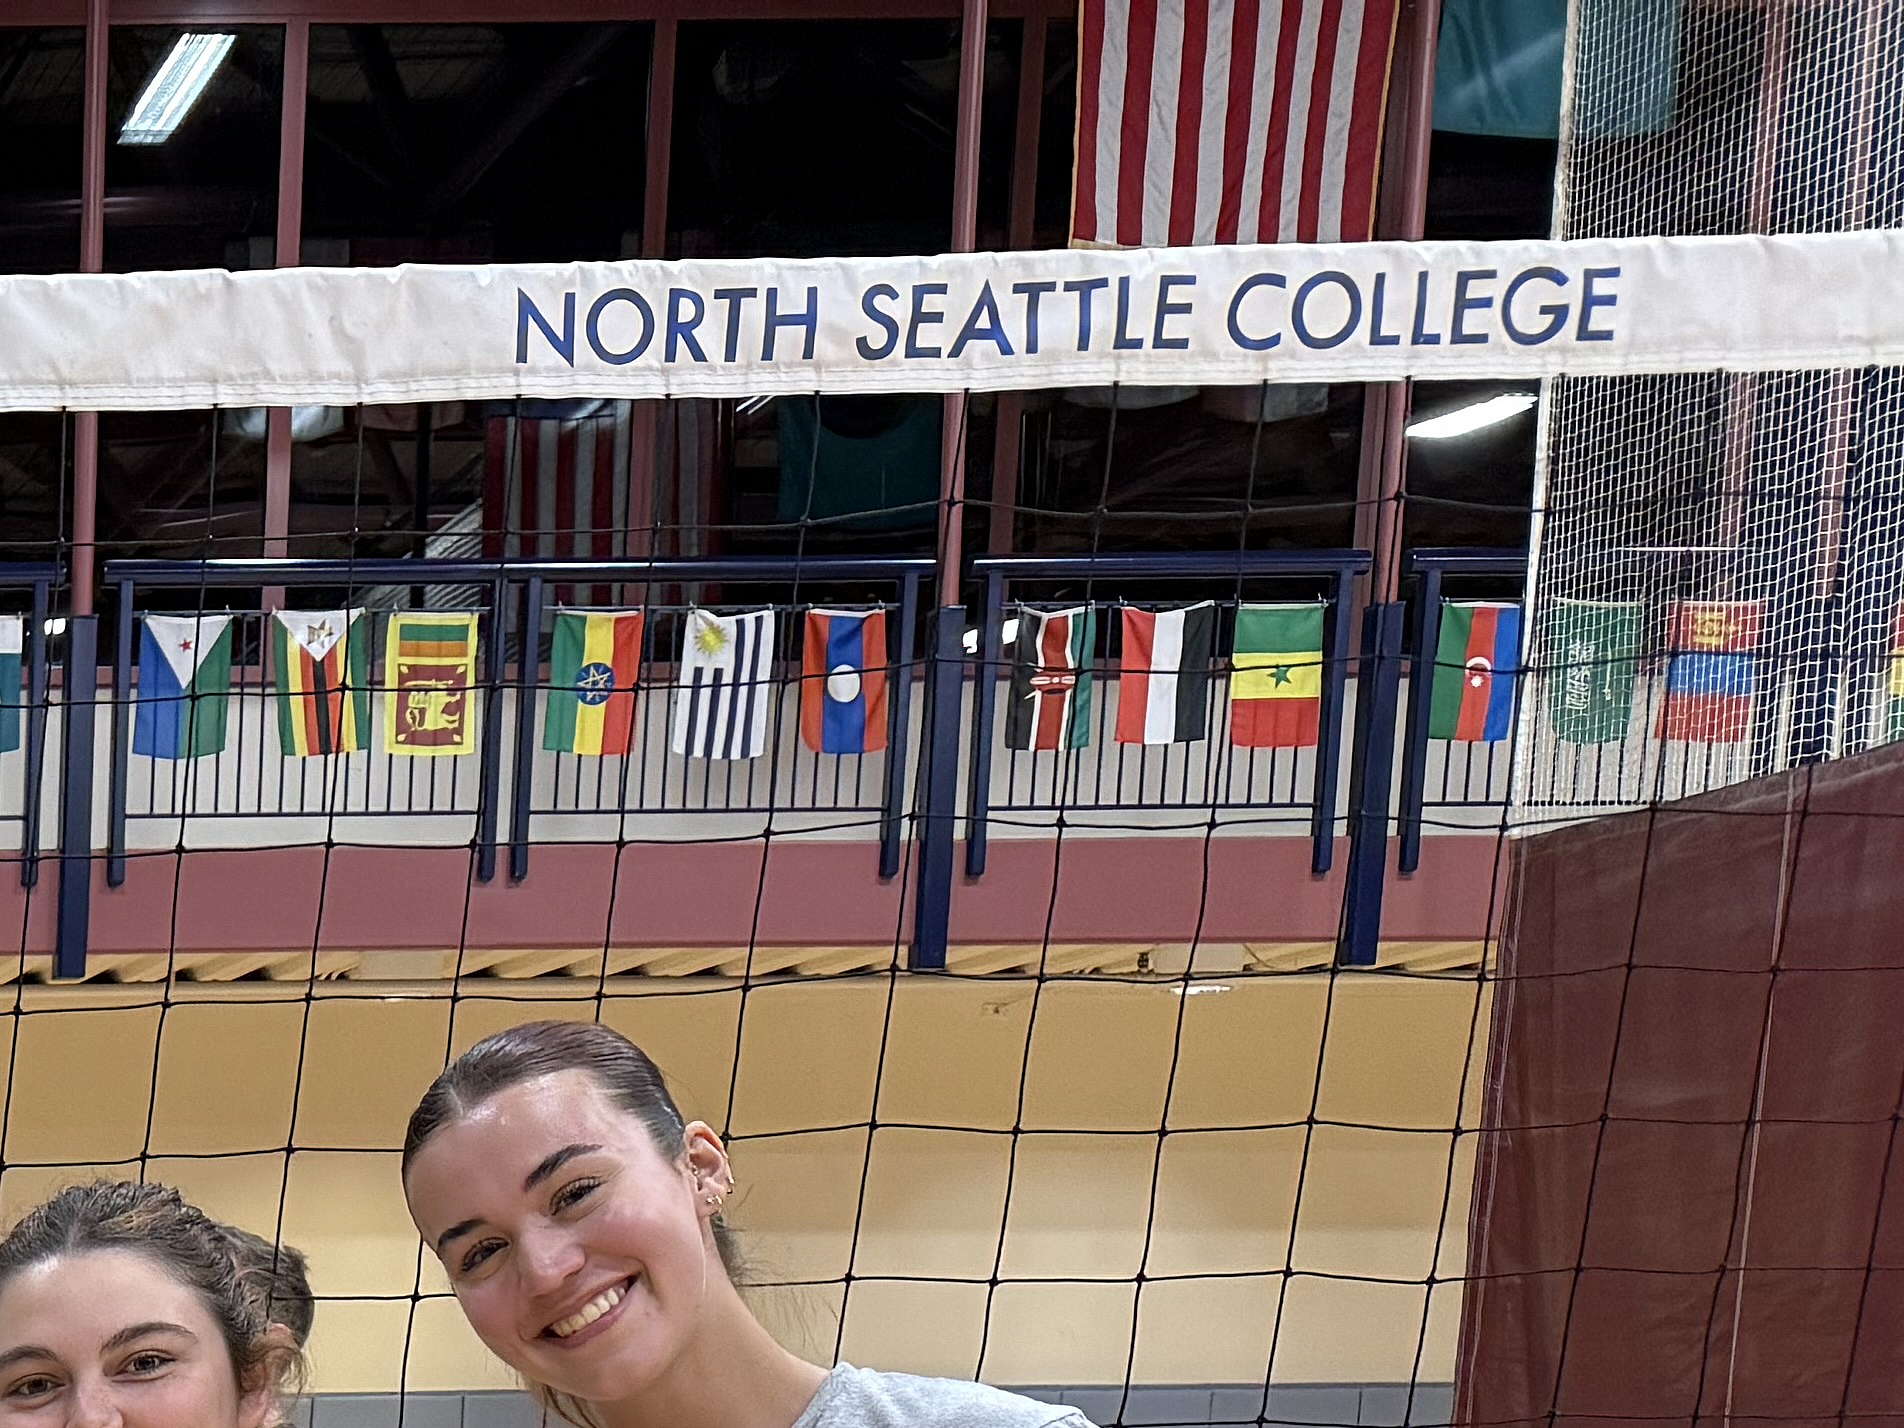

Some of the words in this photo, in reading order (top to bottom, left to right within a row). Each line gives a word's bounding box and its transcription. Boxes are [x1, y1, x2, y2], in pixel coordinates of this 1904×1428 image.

[515, 287, 819, 366] NORTH
[855, 275, 1198, 359] SEATTLE
[1229, 267, 1623, 351] COLLEGE
